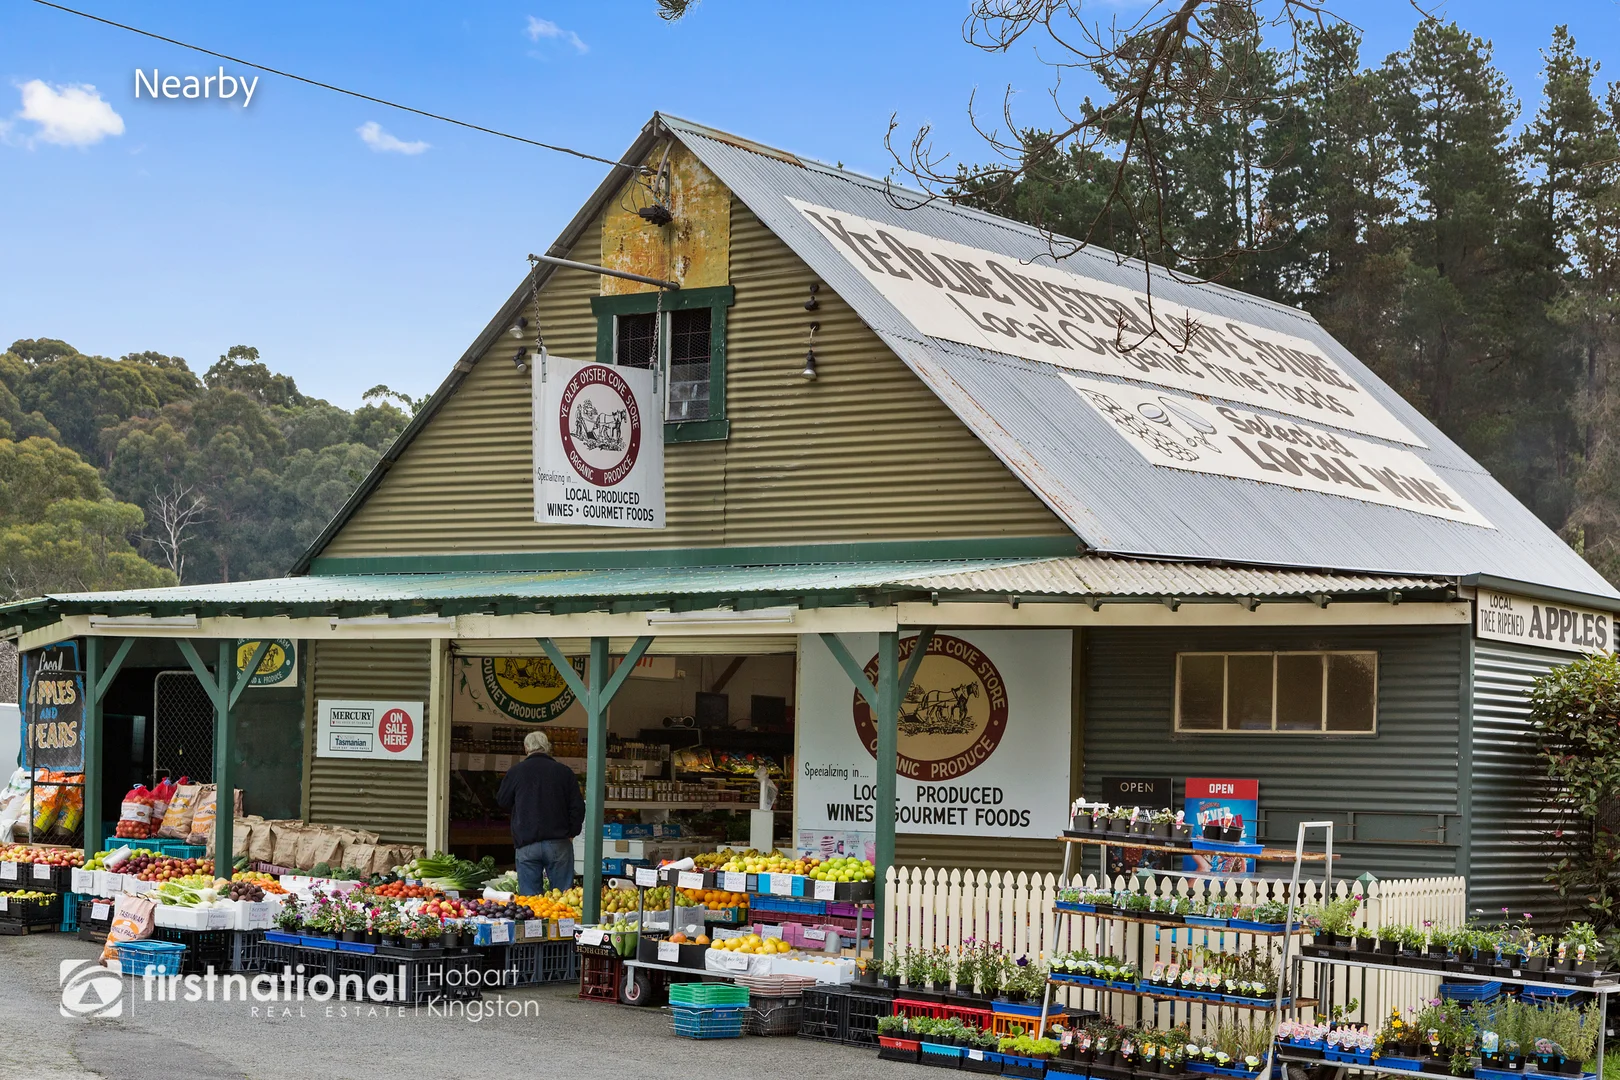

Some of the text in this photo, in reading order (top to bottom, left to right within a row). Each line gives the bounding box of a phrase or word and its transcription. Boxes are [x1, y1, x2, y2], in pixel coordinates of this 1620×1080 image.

[803, 209, 1360, 393] YE OLDE OYSTER COVE STORE
[946, 293, 1355, 417] Local Organic Fine Foods
[560, 368, 640, 430] YE OLDE OYSTER COVE STORE
[1216, 406, 1359, 460] Selected
[569, 451, 633, 484] ORGANIC PRODUCE
[1227, 435, 1381, 493] LOCAL
[537, 467, 565, 485] Specializing
[565, 488, 640, 505] LOCAL PRODUCED
[547, 503, 655, 522] WINES GOURMET FOODS
[1490, 594, 1513, 611] LOCAL
[1480, 609, 1525, 637] TREE RIPENED
[1528, 605, 1608, 649] APPLES
[946, 640, 980, 666] COVE
[978, 662, 1006, 711] STORE
[484, 658, 508, 705] OURMET
[508, 702, 547, 719] PRODUCE
[40, 707, 58, 719] AND
[332, 711, 372, 721] MERCURY
[390, 712, 403, 724] ON
[385, 723, 407, 735] SALE
[335, 738, 367, 747] Tasmanian
[383, 735, 408, 746] HERE
[931, 735, 995, 778] PRODUCE
[804, 762, 848, 781] Specializing
[916, 785, 1004, 805] PRODUCED
[1120, 782, 1154, 793] OPEN
[1209, 783, 1234, 794] OPEN
[827, 804, 1031, 828] WINES GOURMET FOODS
